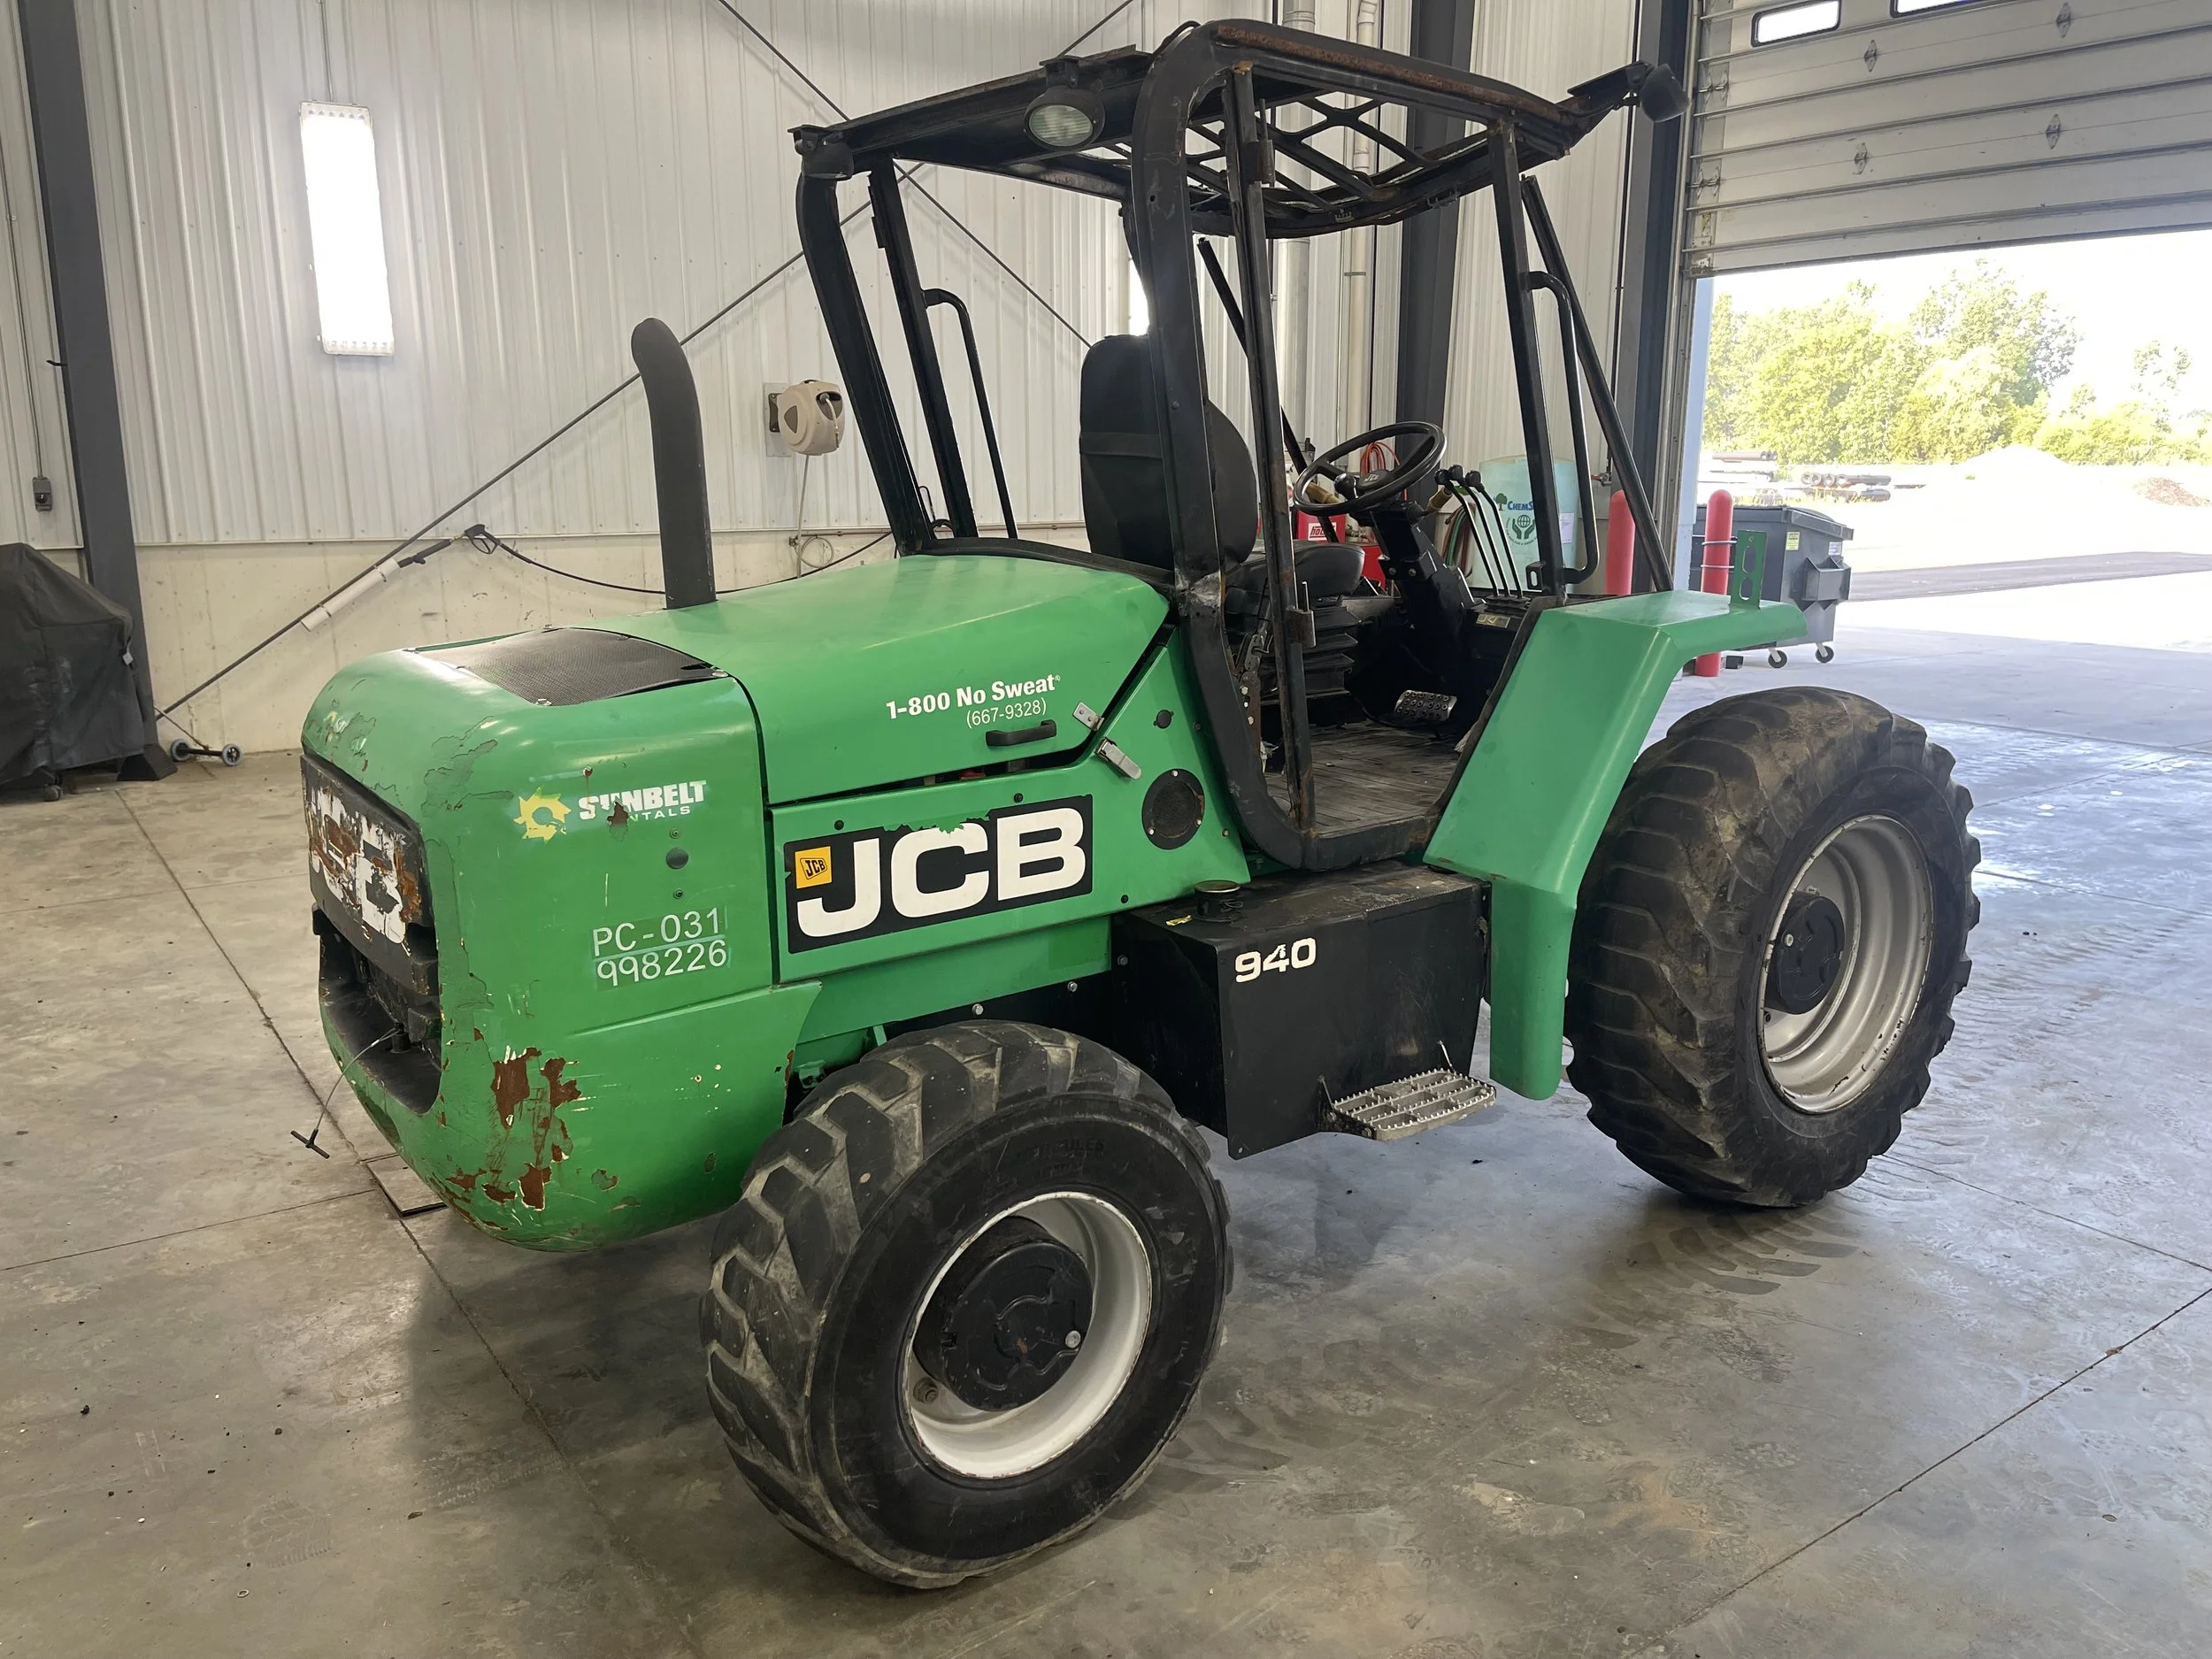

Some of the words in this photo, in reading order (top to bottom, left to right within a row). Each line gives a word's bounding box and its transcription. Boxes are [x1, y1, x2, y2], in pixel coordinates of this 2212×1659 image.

[1507, 501, 1534, 511] CHEMS
[886, 692, 951, 719] 1-800
[956, 687, 987, 708] No
[966, 697, 1047, 729] (667-9328)
[796, 807, 1087, 938] JCB
[804, 859, 826, 877] JCB
[592, 907, 719, 957] PC-031
[596, 939, 728, 987] 998226
[1235, 937, 1317, 983] 940
